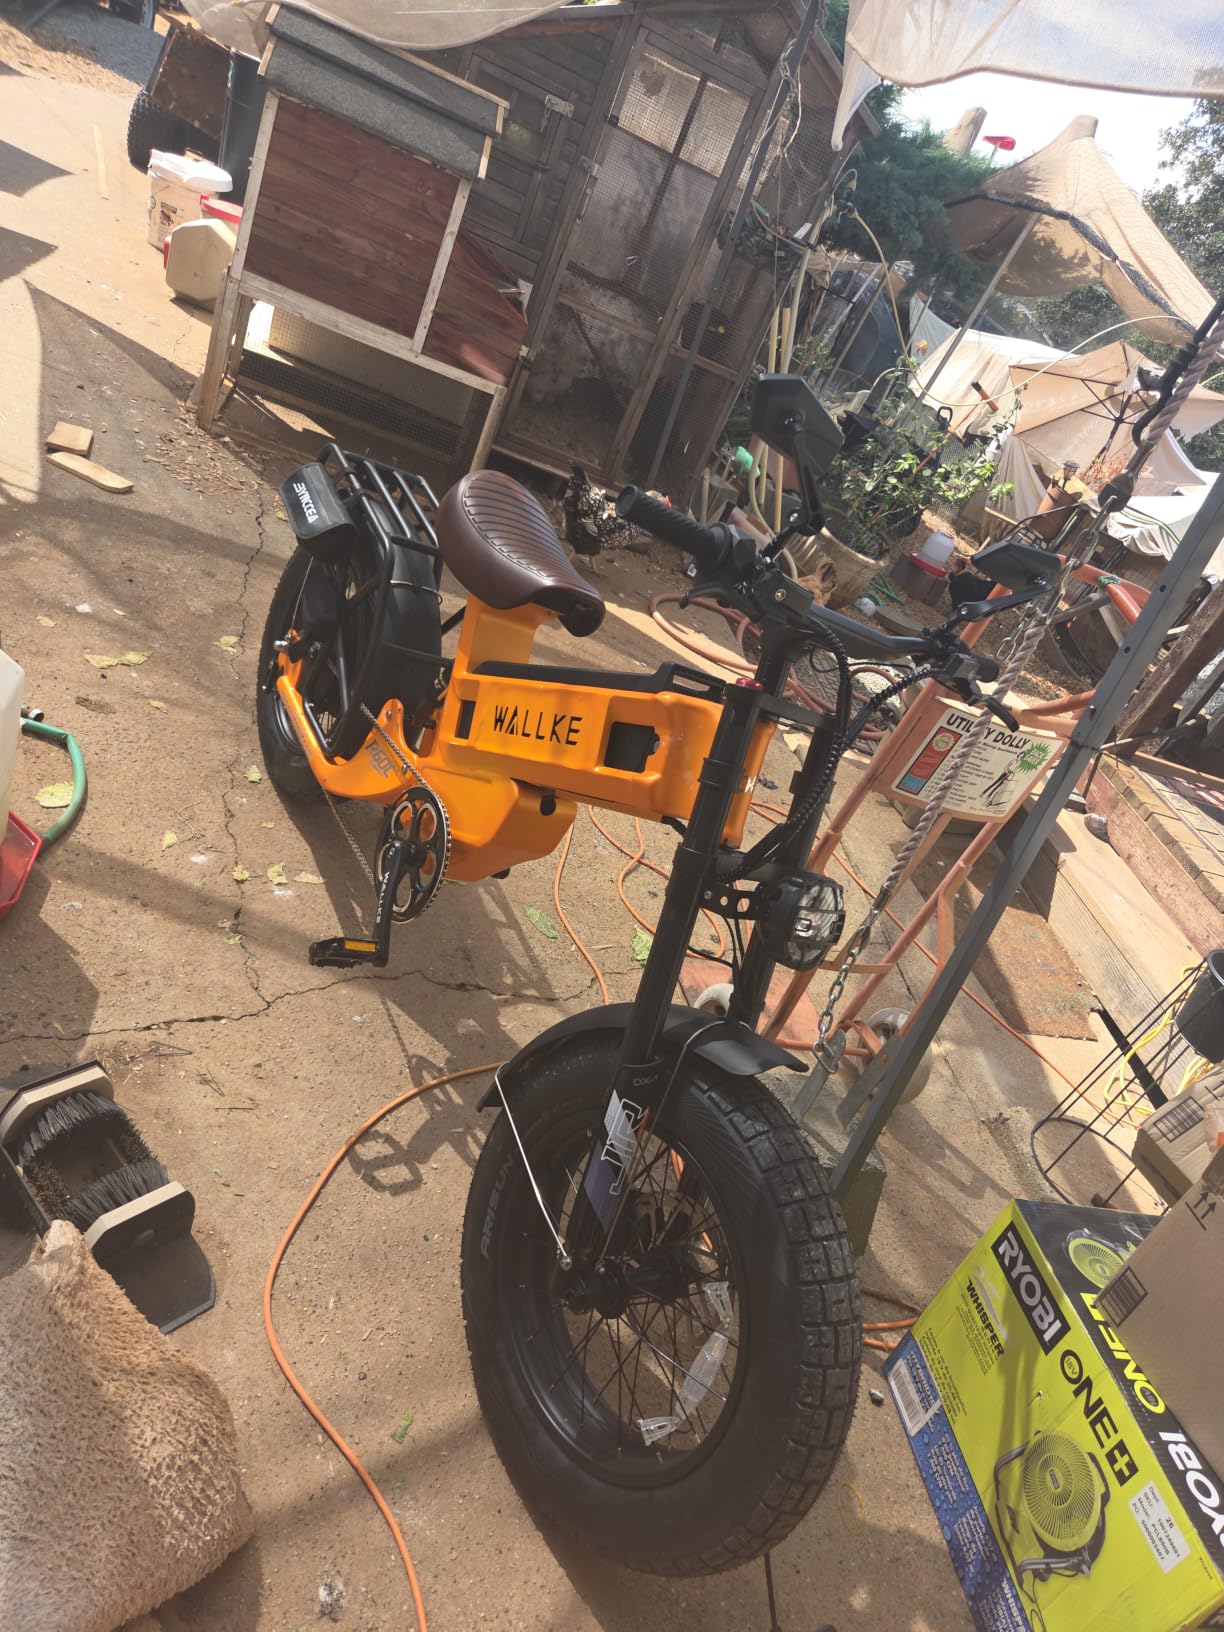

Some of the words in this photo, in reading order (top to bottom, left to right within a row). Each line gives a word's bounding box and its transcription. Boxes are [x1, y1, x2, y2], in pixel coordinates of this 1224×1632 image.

[492, 704, 583, 746] WALLKE
[945, 712, 996, 739] UTILY
[992, 730, 1031, 750] DOLLY
[374, 870, 390, 924] WALLKE
[480, 1152, 515, 1259] ARISUN
[964, 1276, 1007, 1357] WHISPER
[997, 1230, 1062, 1342] RYOBI
[1159, 1429, 1223, 1548] YOBI
[1165, 1515, 1174, 1530] 26
